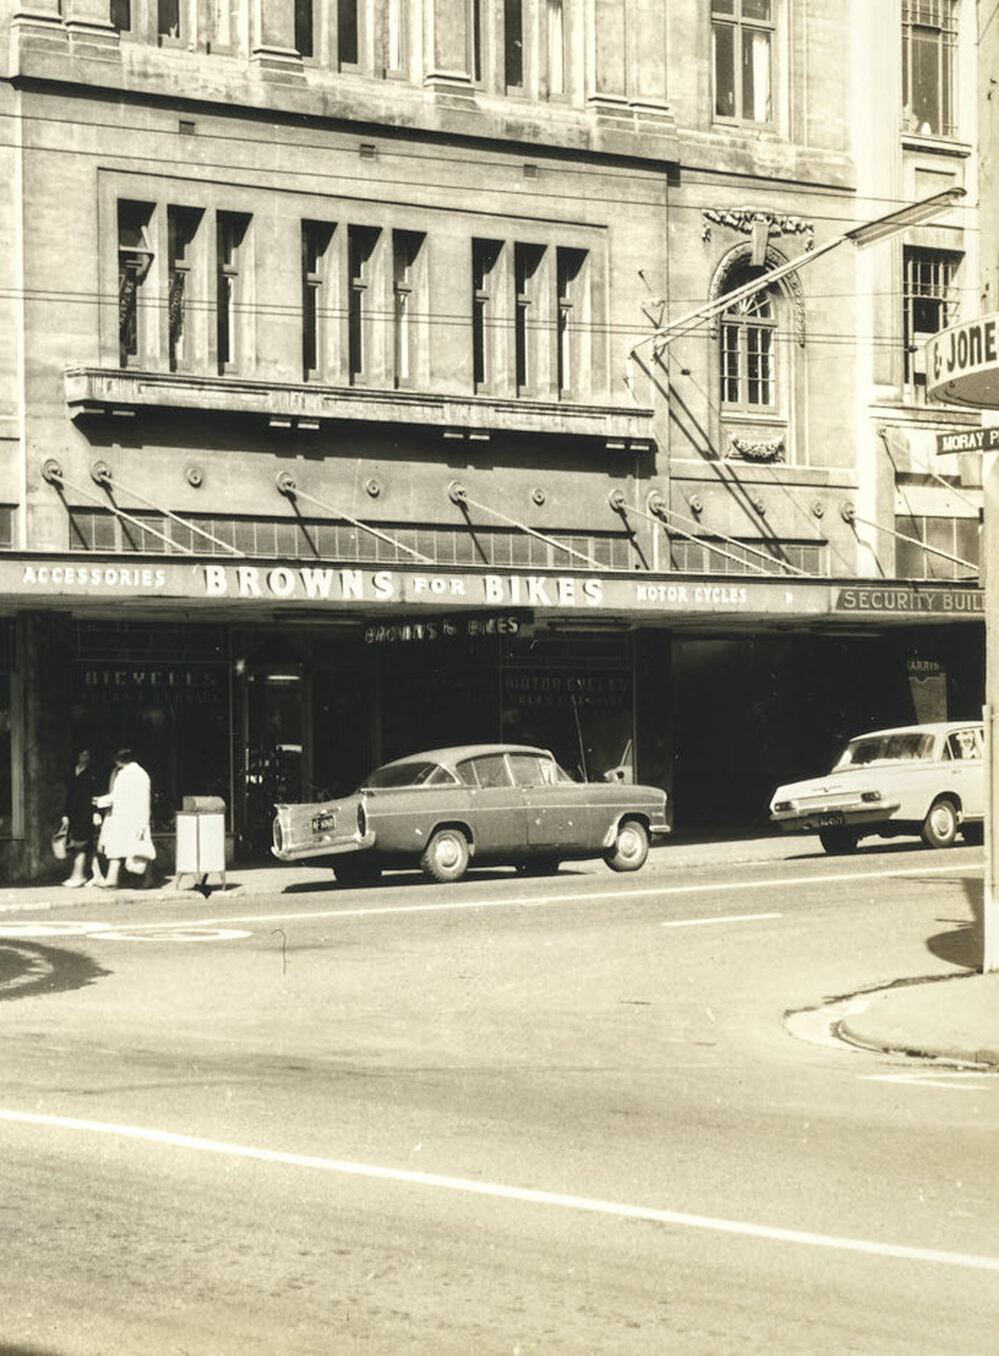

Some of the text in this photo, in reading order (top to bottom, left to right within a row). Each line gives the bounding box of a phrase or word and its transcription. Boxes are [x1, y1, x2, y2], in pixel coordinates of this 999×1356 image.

[942, 430, 999, 451] MORAY P
[22, 564, 748, 607] ACCESSORIES BROWNS FOR BIKES MOTOR CYCLES
[843, 591, 984, 612] SECURITY BUIL
